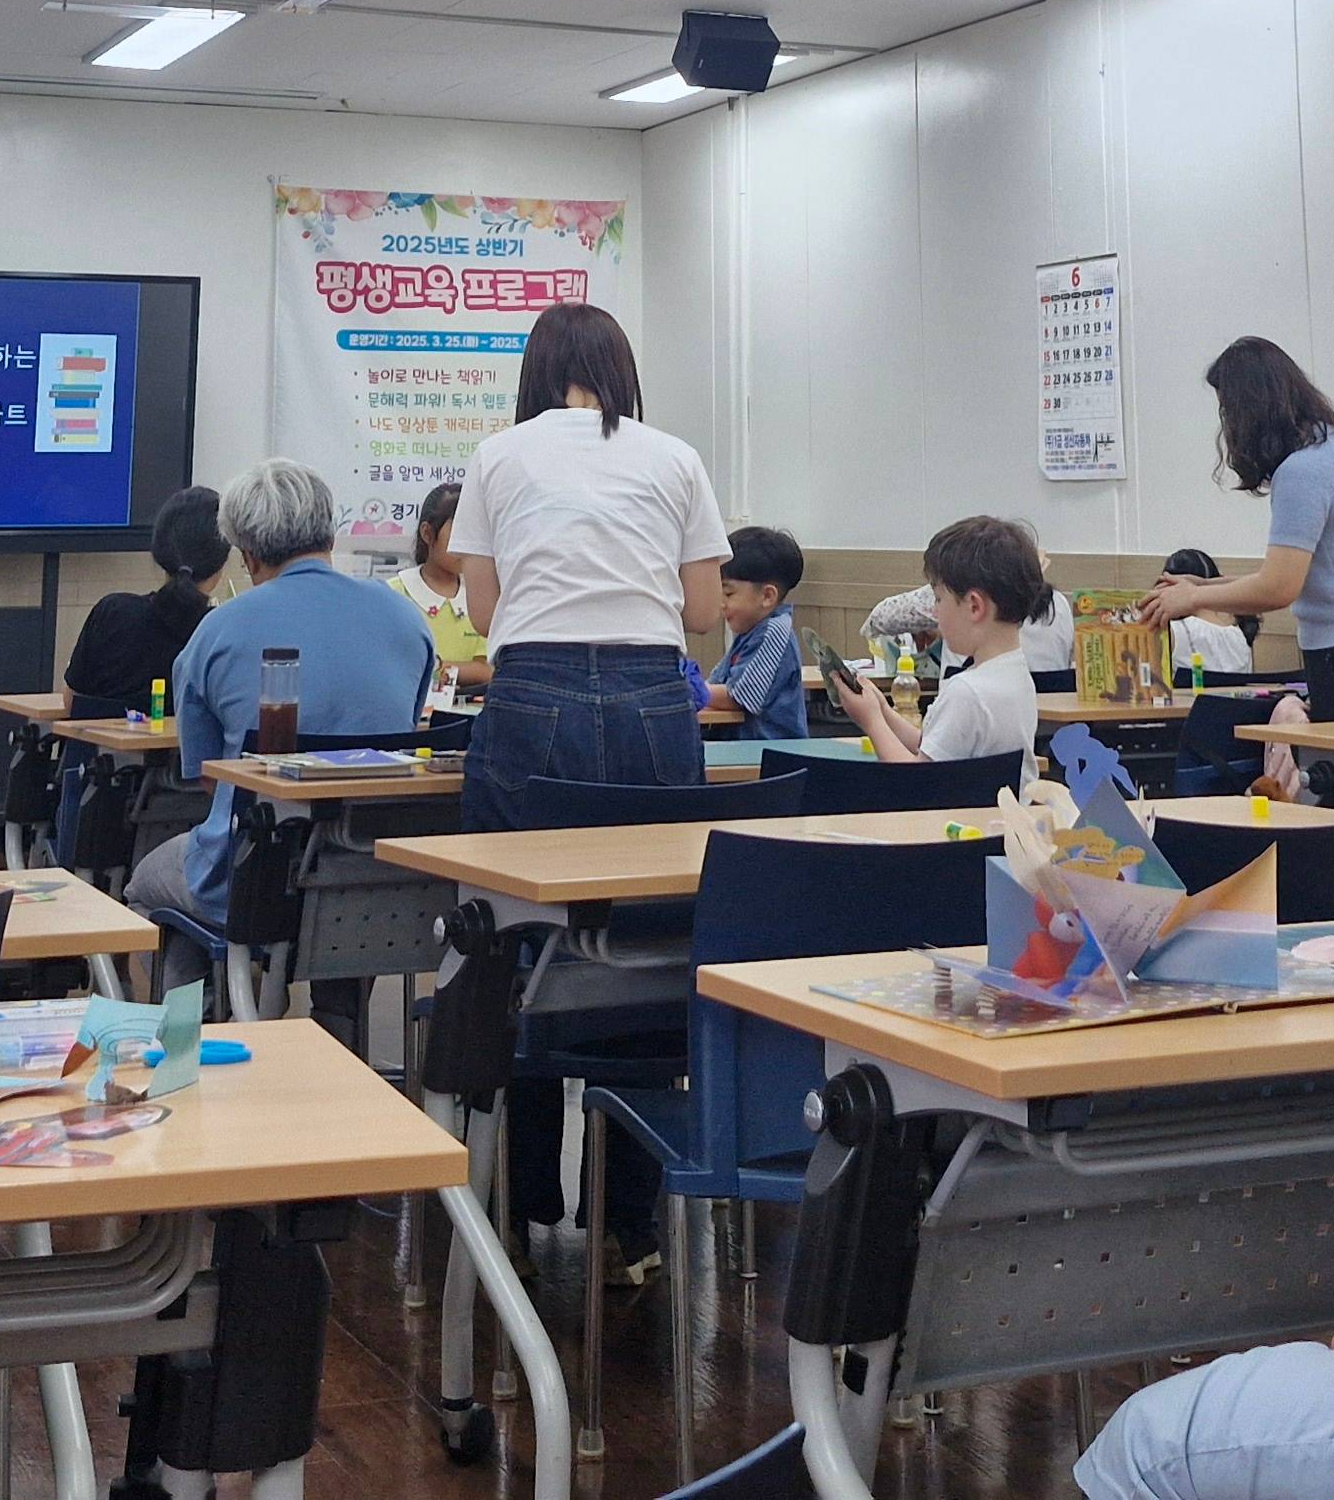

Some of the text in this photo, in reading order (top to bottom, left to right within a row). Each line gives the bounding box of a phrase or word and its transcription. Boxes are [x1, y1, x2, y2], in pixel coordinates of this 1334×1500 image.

[381, 234, 524, 257] 2025년도 상반기
[1072, 266, 1080, 288] 6
[316, 261, 588, 315] 평생교육 프로그램
[1053, 326, 1058, 338] 9
[1063, 325, 1070, 336] 10
[1073, 324, 1080, 335] 11
[1083, 323, 1090, 334] 12
[1094, 322, 1101, 333] 13
[1104, 320, 1112, 331] 14
[396, 334, 427, 347] 2025.
[433, 335, 444, 348] 3.
[489, 337, 523, 349] 2025.
[1044, 345, 1112, 362] 15 16 17 18 19 20 21
[368, 368, 497, 385] 놀이로 만나는 책읽기
[1043, 370, 1113, 386] 22 23 24 25 26 27 28
[368, 392, 408, 409] 문해력
[413, 393, 446, 408] 파워!
[451, 393, 477, 409] 독서
[482, 393, 507, 410] 웹툰
[1043, 397, 1061, 410] 29 30
[369, 417, 394, 431] 나도
[398, 416, 439, 434] 일상툰
[444, 418, 484, 433] 캐릭터
[369, 440, 407, 457] 영화로
[412, 442, 452, 458] 떠나는
[369, 464, 394, 482] 글을
[399, 466, 424, 482] 알면
[391, 503, 420, 520] 경기
